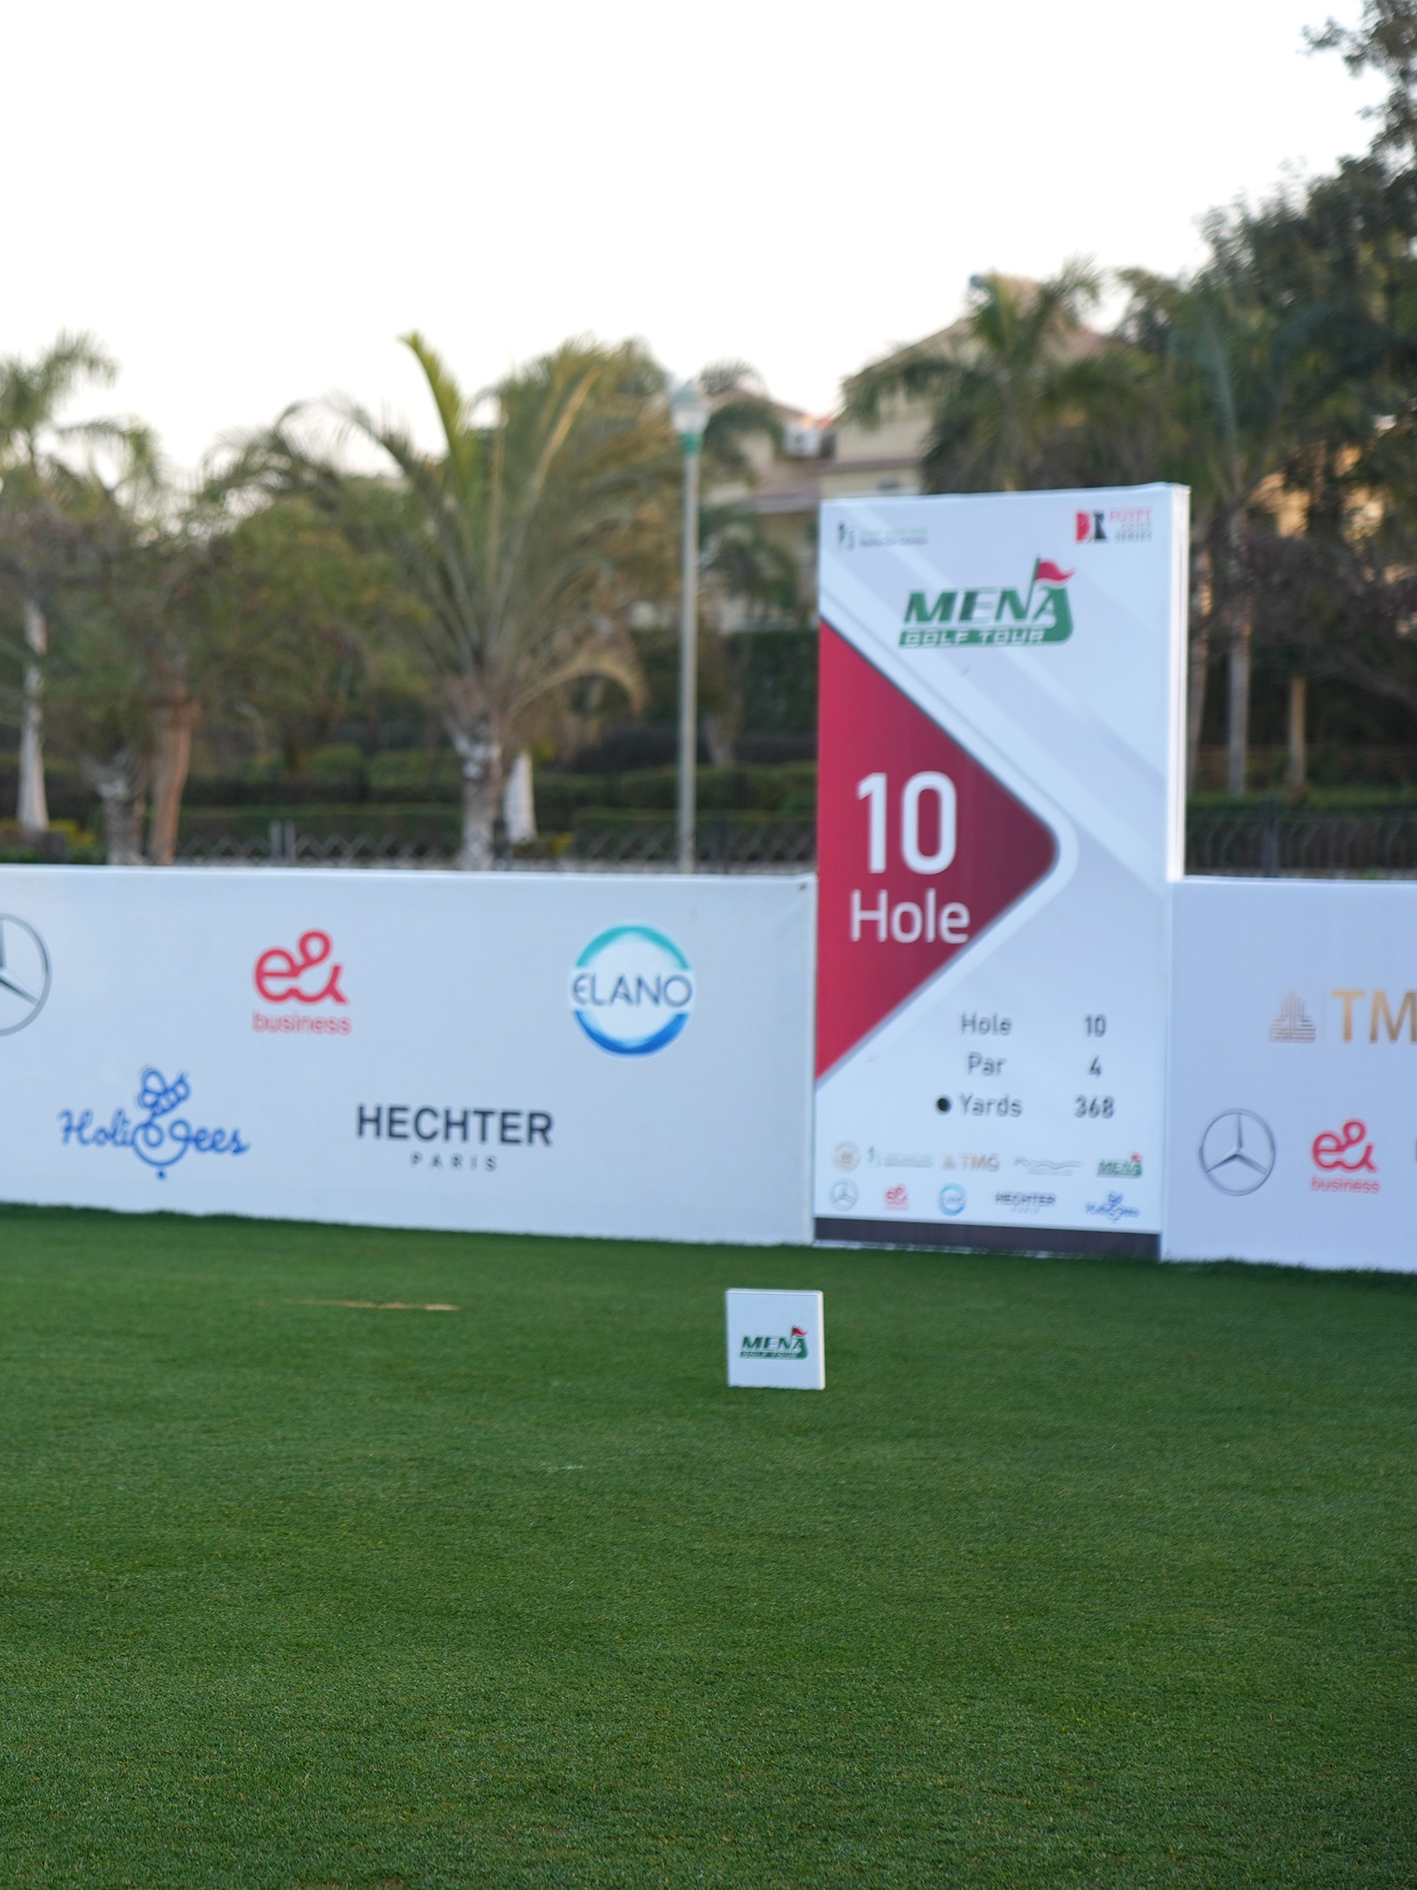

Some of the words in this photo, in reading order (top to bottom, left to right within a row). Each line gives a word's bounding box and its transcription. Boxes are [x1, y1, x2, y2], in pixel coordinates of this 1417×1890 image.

[903, 573, 1074, 624] MENA
[904, 629, 970, 645] GOLF
[978, 628, 1045, 645] TOUR
[857, 770, 958, 875] 10
[850, 887, 971, 944] Hole
[253, 1010, 352, 1035] business
[960, 1012, 1013, 1036] Hole
[1084, 1013, 1107, 1037] 10
[967, 1051, 1007, 1076] Par
[1088, 1055, 1103, 1078] 4
[958, 1092, 1024, 1118] Yards
[1074, 1094, 1115, 1119] 368
[356, 1103, 555, 1148] HECHTER
[411, 1151, 499, 1172] PARIS
[1310, 1176, 1381, 1194] business
[742, 1332, 804, 1351] MENA
